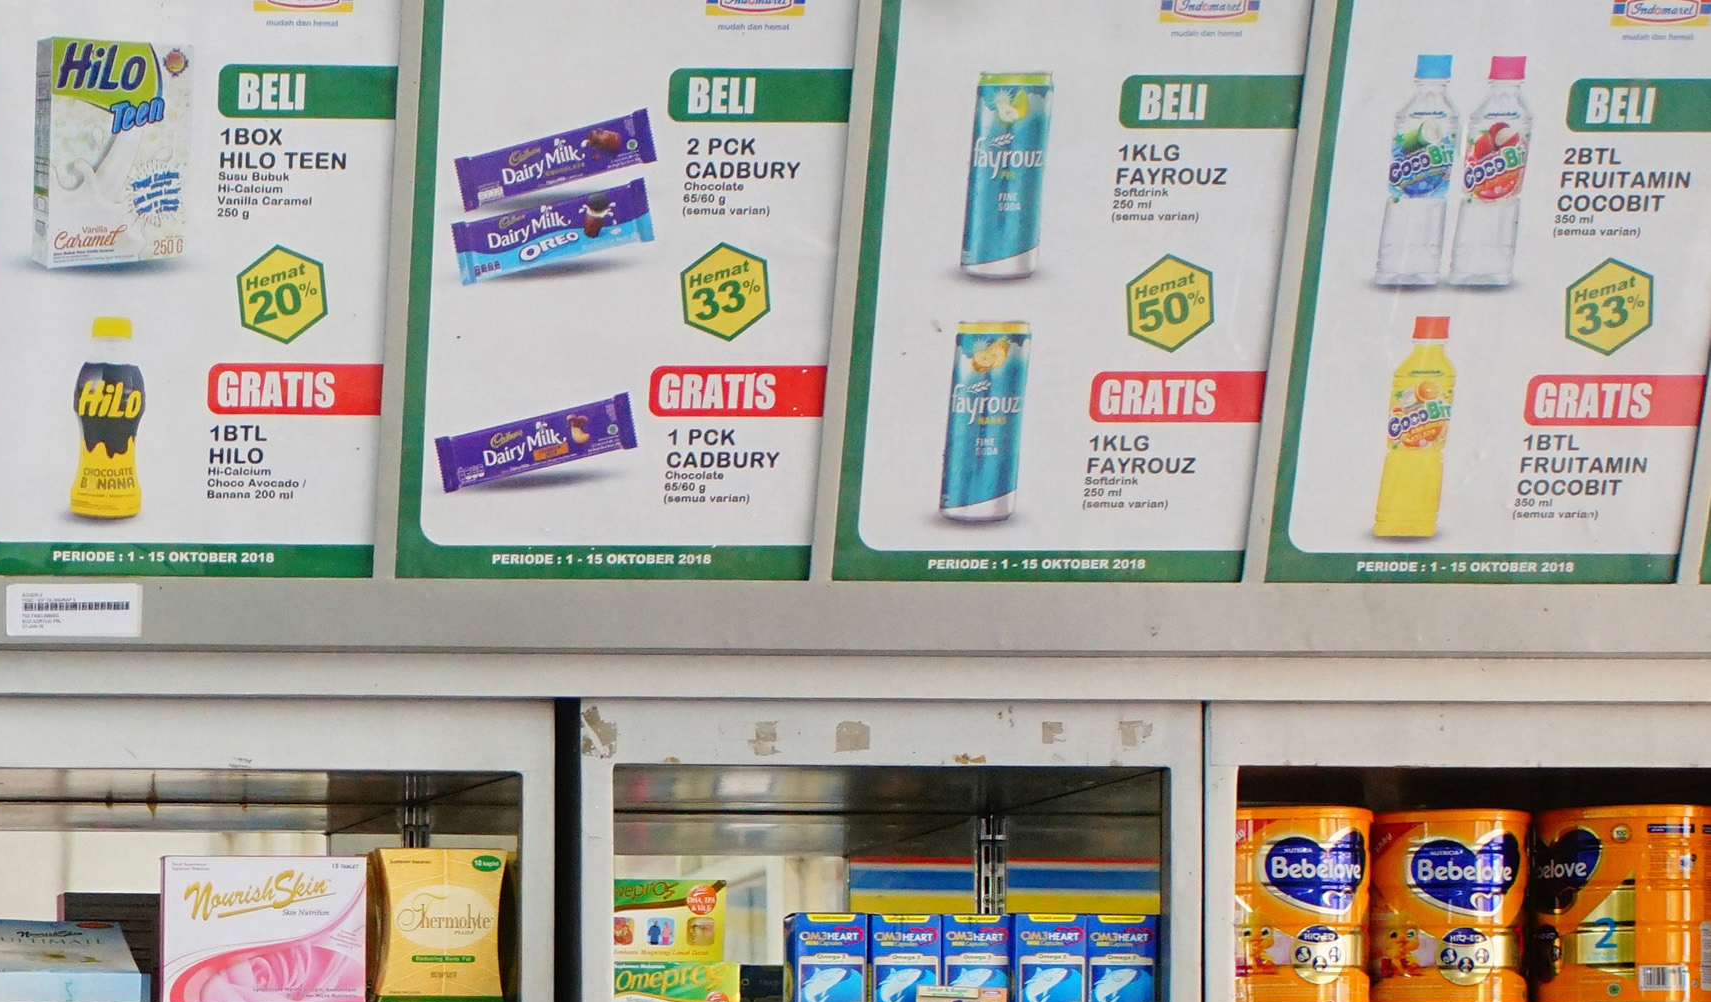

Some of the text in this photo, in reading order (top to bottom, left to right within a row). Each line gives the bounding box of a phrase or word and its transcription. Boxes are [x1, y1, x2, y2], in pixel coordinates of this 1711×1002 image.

[57, 41, 146, 93] HiLo
[238, 73, 306, 110] BELI
[687, 77, 757, 115] BELI
[1138, 83, 1208, 120] BELI
[1585, 87, 1657, 124] BELI
[110, 96, 165, 134] Teen
[220, 128, 283, 146] 1BOX
[687, 138, 757, 155] 2 PCK
[1118, 144, 1180, 162] 1KLG
[220, 152, 348, 170] HILO TEEN
[502, 160, 545, 186] Dairy
[544, 140, 585, 167] Milk
[972, 136, 1044, 180] fayrouz
[1564, 148, 1621, 165] 2BTL
[218, 172, 290, 182] Susu Bubuk
[686, 162, 801, 180] CADBURY
[1116, 168, 1228, 185] FAYROUZ
[218, 184, 284, 195] Hi-Calcium
[684, 182, 744, 192] Chocolate
[1560, 172, 1691, 189] FRUITAMIN
[217, 196, 313, 206] Vanilla Caramel
[683, 194, 726, 206] 65/60 g
[1114, 188, 1169, 197] Softdrink
[682, 206, 770, 217] (semua varian)
[1112, 200, 1152, 209] 250 ml
[1557, 195, 1665, 212] COCOBIT
[217, 208, 250, 221] 250 g
[1111, 211, 1199, 223] (semua varian)
[1555, 215, 1594, 224] 350 ml
[487, 224, 530, 249] Dairy
[531, 212, 571, 234] Milk
[519, 231, 580, 262] OREO
[246, 262, 307, 290] Hemat
[689, 259, 750, 289] Hemat
[1134, 271, 1196, 300] Hemat
[1573, 275, 1637, 304] Hemat
[248, 281, 318, 326] 20%
[691, 278, 761, 321] 33%
[1138, 288, 1206, 332] 50%
[1575, 295, 1646, 336] 33%
[217, 371, 336, 409] GRATIS
[657, 373, 777, 410] GRATIS
[1097, 379, 1217, 416] GRATIS
[78, 380, 142, 419] HiLo
[951, 382, 1020, 425] fayrouz
[1533, 382, 1653, 419] GRATIS
[210, 425, 268, 442] 1BTL
[669, 429, 736, 446] 1 PCK
[1090, 435, 1150, 452] 1KLG
[1522, 435, 1580, 451] 1BTL
[209, 448, 265, 465] HILO
[666, 452, 780, 469] CADBURY
[1087, 457, 1196, 474] FAYROUZ
[1520, 457, 1648, 474] FRUITAMIN
[1517, 480, 1623, 496] COCOBIT
[52, 551, 275, 563] PERIODE 15 OKTOBER 2018
[491, 554, 712, 565] PERIODE 15 OKTOBER 2018
[1270, 855, 1361, 880] Bebelove
[1417, 859, 1513, 882] Bebelove
[183, 869, 330, 922] NourishSkin
[1594, 917, 1618, 949] 2
[615, 964, 730, 991] Omepros
